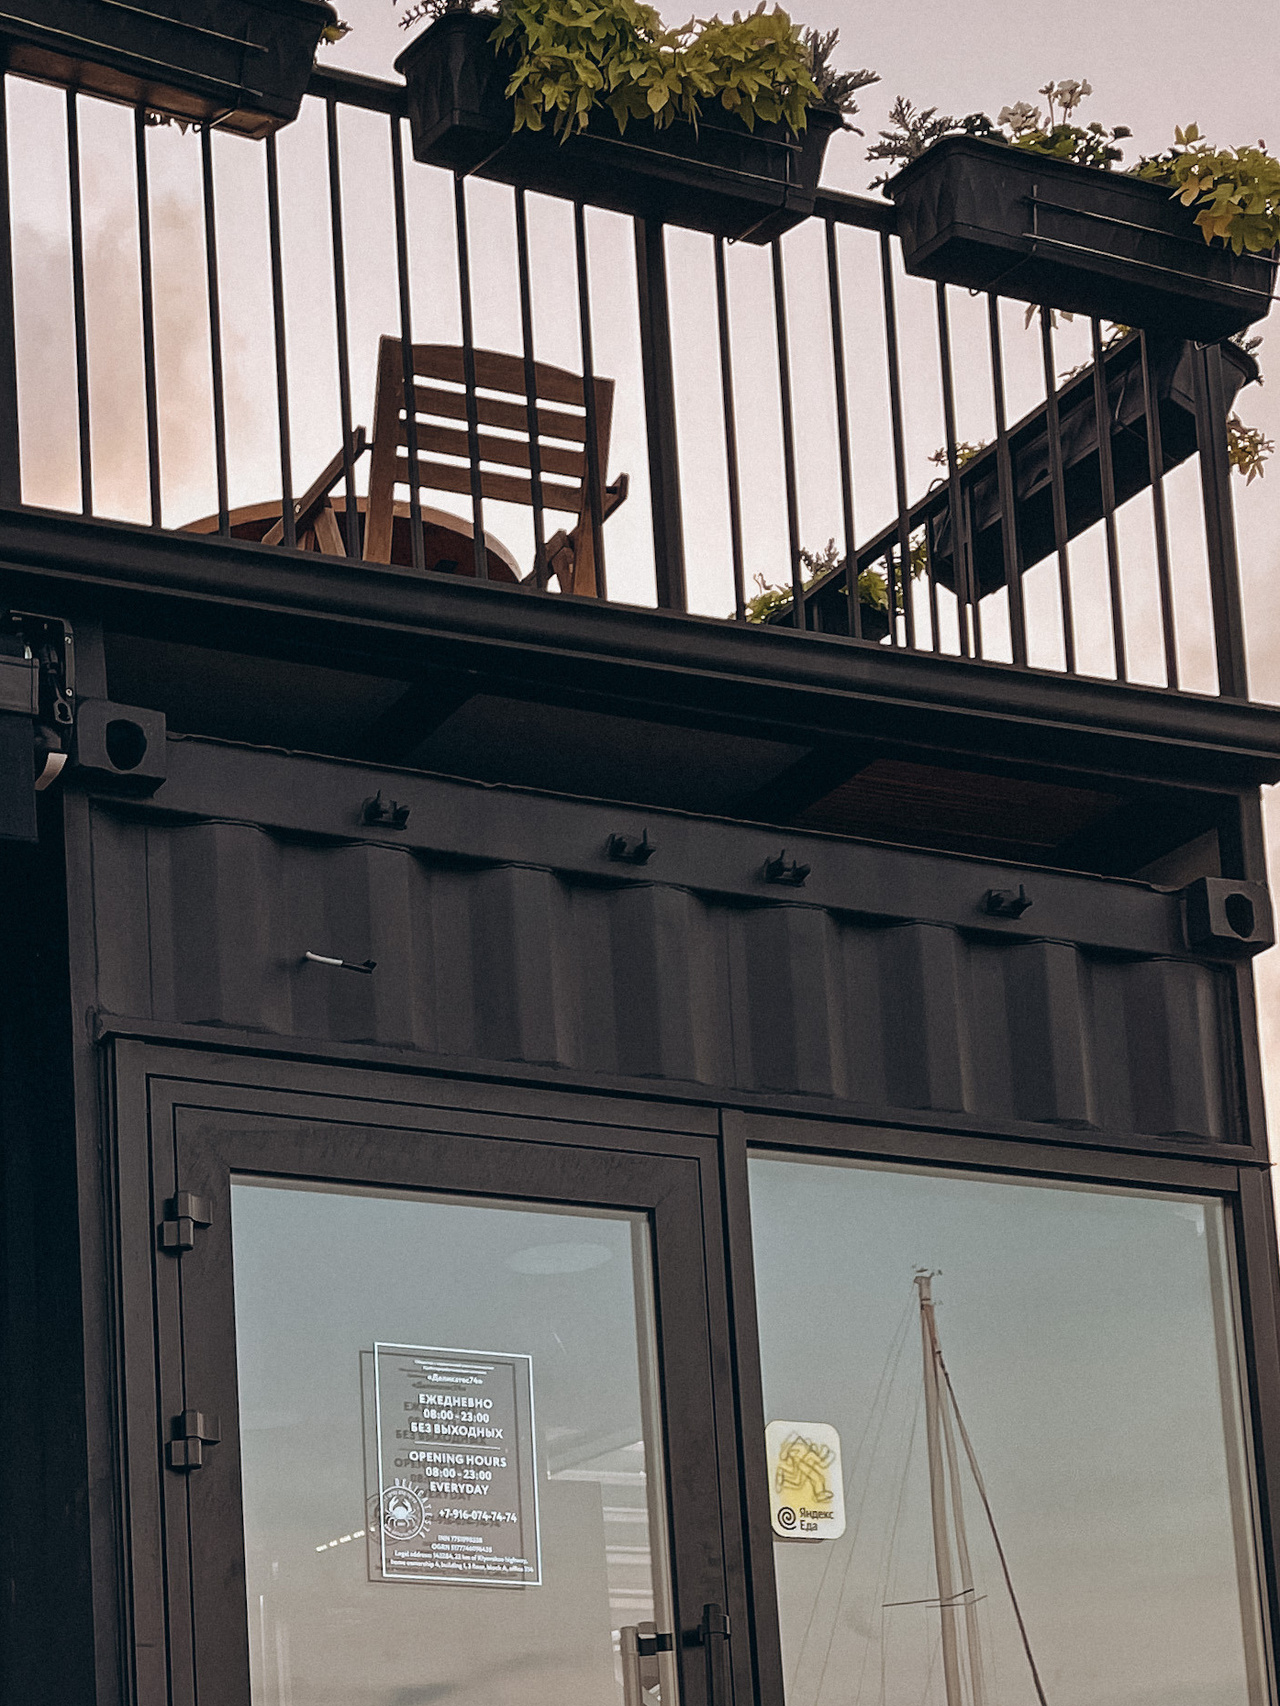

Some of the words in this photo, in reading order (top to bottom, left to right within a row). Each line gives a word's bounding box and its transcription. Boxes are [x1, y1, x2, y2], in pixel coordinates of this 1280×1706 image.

[418, 1393, 493, 1409] ЕЖЕДНЕВНО
[423, 1408, 454, 1420] 08:00
[461, 1411, 490, 1423] 23:00
[411, 1422, 432, 1433] БЕЗ
[434, 1424, 504, 1439] ВЫХОДНЫХ
[409, 1451, 464, 1465] OPENING
[466, 1454, 507, 1468] HOURS
[425, 1466, 456, 1478] 08:00
[463, 1469, 492, 1481] 23:00
[430, 1481, 490, 1495] EVERYDAY
[439, 1508, 518, 1523] +7-916-074-74-74
[799, 1507, 834, 1520] Яндекс
[799, 1519, 818, 1532] Еда
